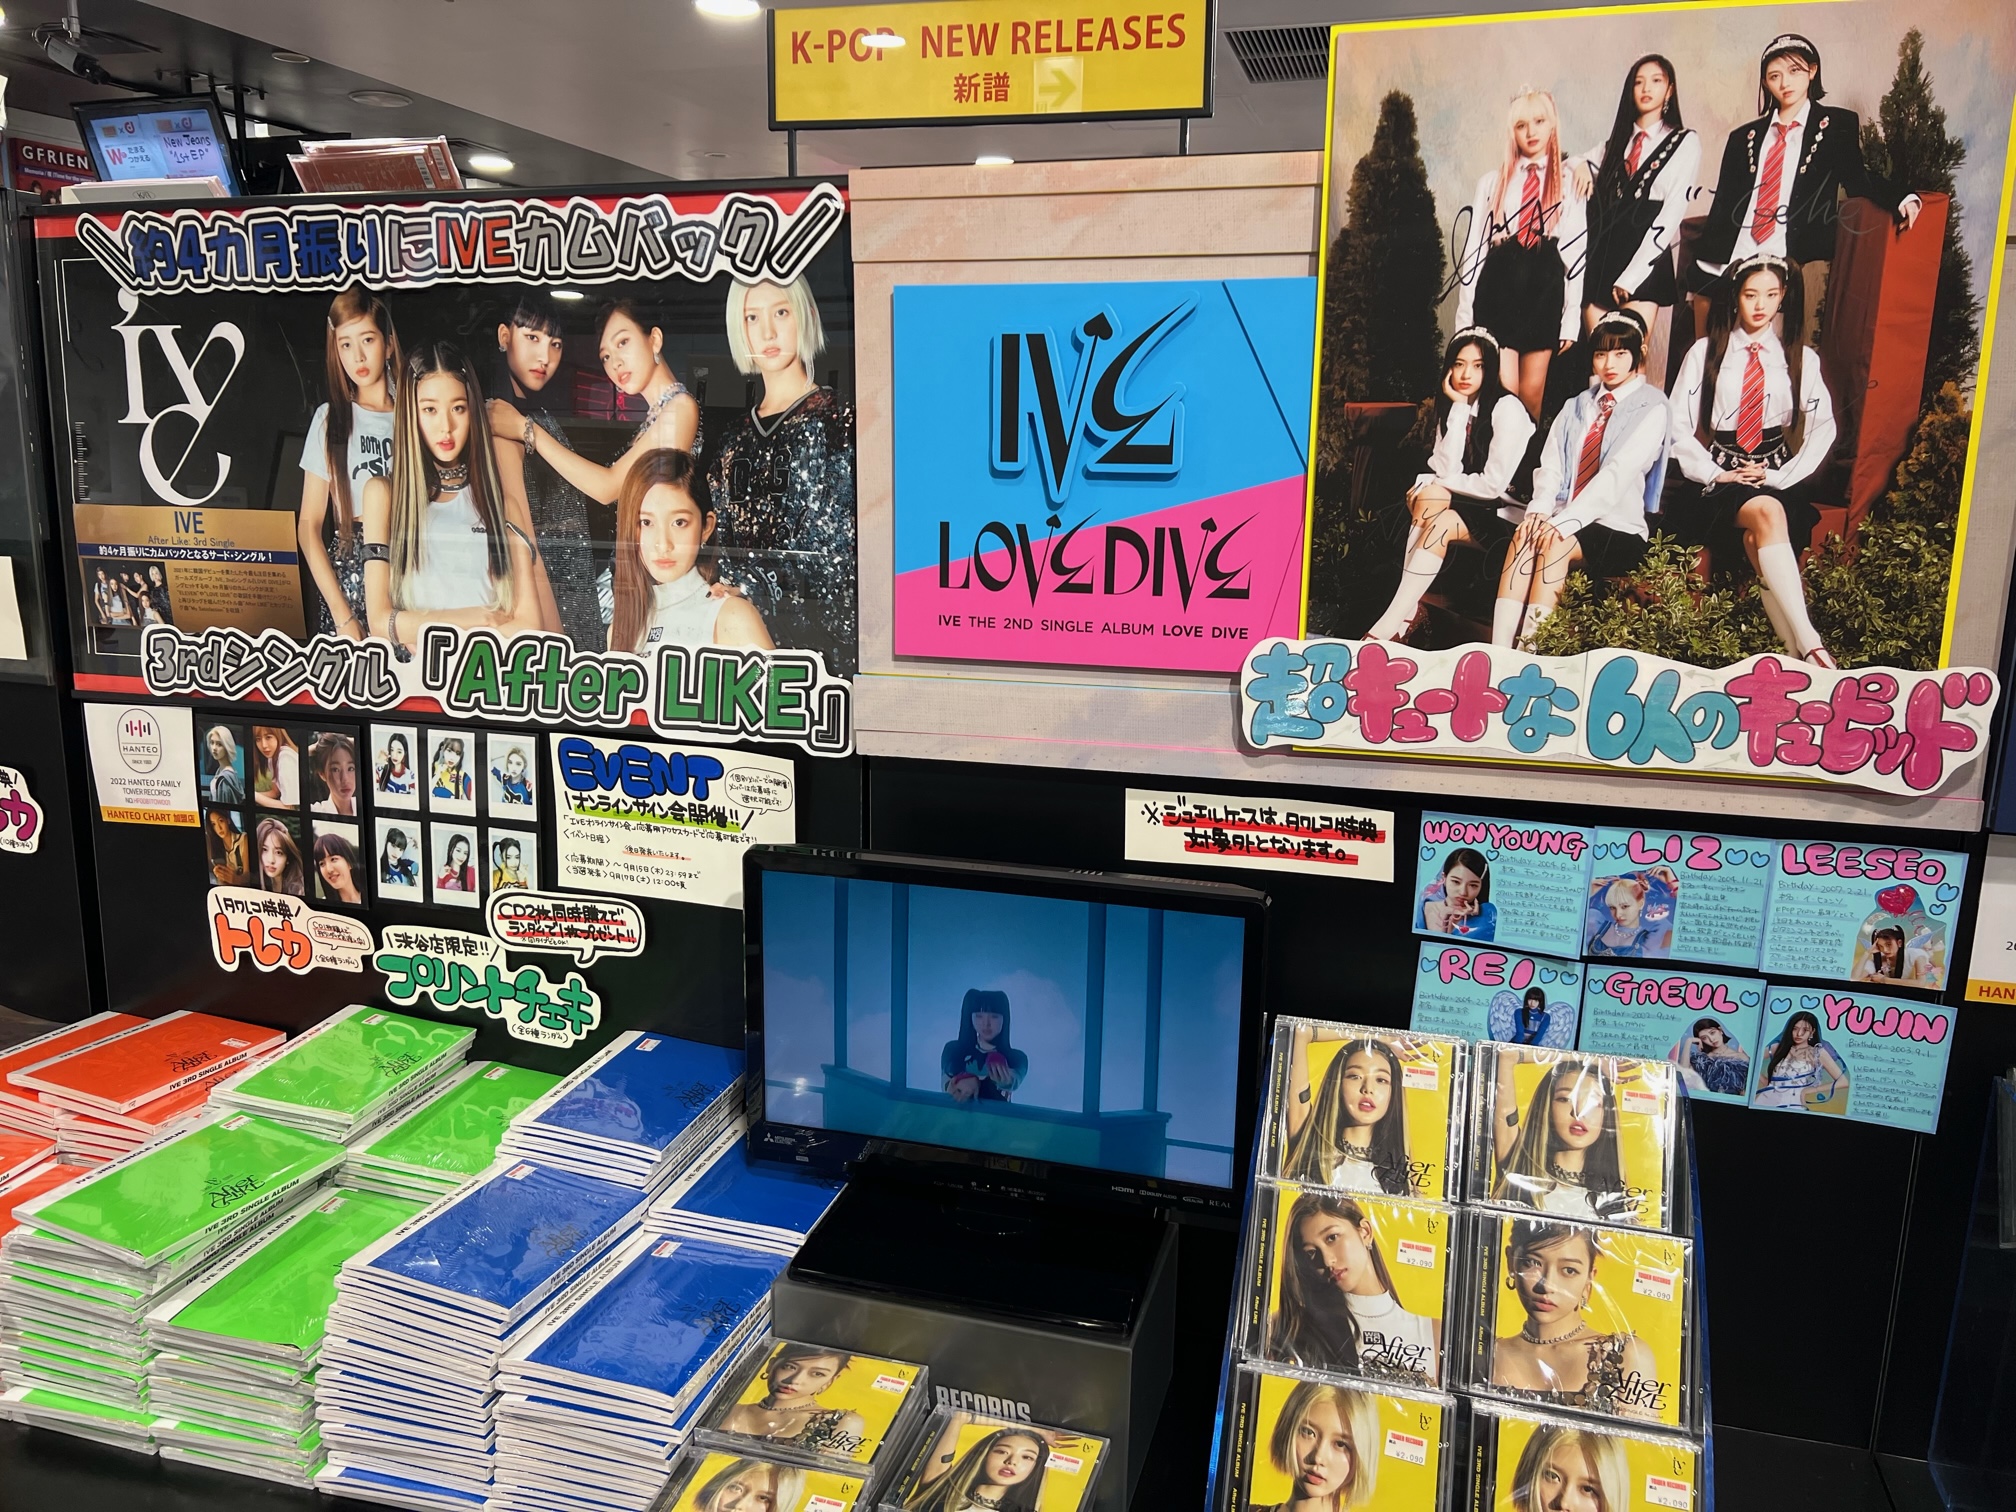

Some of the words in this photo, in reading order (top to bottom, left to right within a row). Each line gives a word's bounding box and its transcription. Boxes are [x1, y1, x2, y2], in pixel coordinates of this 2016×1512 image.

[791, 27, 895, 64] K-POP
[921, 22, 999, 58] NEW
[1011, 13, 1186, 55] RELEASES
[953, 72, 1010, 103] 新譜
[22, 145, 89, 170] GFRIEN
[163, 137, 178, 148] New
[182, 134, 211, 147] Jeans
[1000, 298, 1191, 495] IVE
[148, 535, 170, 546] After
[193, 538, 207, 547] 3rd
[210, 538, 235, 549] Single
[174, 511, 205, 534] IVE
[938, 614, 962, 627] IVE
[969, 616, 996, 629] THE
[1003, 617, 1033, 630] 2ND
[1040, 618, 1094, 633] SINGLE
[1101, 622, 1155, 636] ALBUM
[1162, 624, 1203, 638] LOVE
[1211, 626, 1249, 640] DIVE
[146, 636, 393, 702] 3rdシングル
[423, 632, 638, 716] 『After
[662, 652, 853, 749] LIKE』
[1248, 643, 1992, 791] 超キュートな6人のキューピッド
[122, 745, 158, 754] HANTEO
[558, 737, 724, 801] EVENT
[110, 778, 127, 786] 2022
[128, 778, 155, 787] HANTEO
[157, 779, 181, 788] FAMILY
[144, 788, 171, 797] RECORDS
[107, 810, 141, 820] HANTEO
[143, 811, 171, 822] CHART
[1184, 827, 1346, 861] 対象外となります。
[1422, 820, 1588, 861] WONYOUNG
[1629, 831, 1723, 871] LIZ
[1781, 842, 1945, 885] LEESEO
[214, 912, 313, 969] トレカ
[1438, 949, 1535, 989] REI
[376, 954, 593, 1035] プリントチェキ
[1604, 973, 1740, 1013] GAEUL
[1978, 985, 2016, 1000] HAN
[1822, 995, 1949, 1044] YUJIN
[169, 1081, 182, 1090] IVE
[182, 1075, 197, 1085] 3RD
[198, 1063, 223, 1077] SINGLE
[224, 1053, 248, 1067] ALBUM
[204, 1223, 219, 1234] IVE
[222, 1212, 238, 1224] 3RD
[240, 1195, 270, 1215] SINGLE
[271, 1178, 300, 1197] ALBUM
[396, 1228, 410, 1236] IVE
[411, 1214, 428, 1227] 3RD
[427, 1196, 454, 1216] SINGLE
[455, 1179, 480, 1197] ALBUM
[1111, 1185, 1135, 1194] HDMI
[1209, 1199, 1232, 1209] REAL
[551, 1272, 562, 1284] IVE
[562, 1262, 575, 1274] 3RD
[575, 1243, 597, 1264] SINGLE
[597, 1226, 617, 1246] ALBUM
[544, 1304, 555, 1315] IVE
[555, 1291, 569, 1304] 3RD
[569, 1273, 591, 1293] SINGLE
[591, 1255, 612, 1275] ALBUM
[547, 1315, 562, 1326] IVE
[560, 1301, 576, 1315] 3RD
[575, 1281, 600, 1303] SINGLE
[600, 1260, 623, 1281] ALBUM
[1618, 1368, 1672, 1395] After
[935, 1385, 1032, 1422] RECORDS
